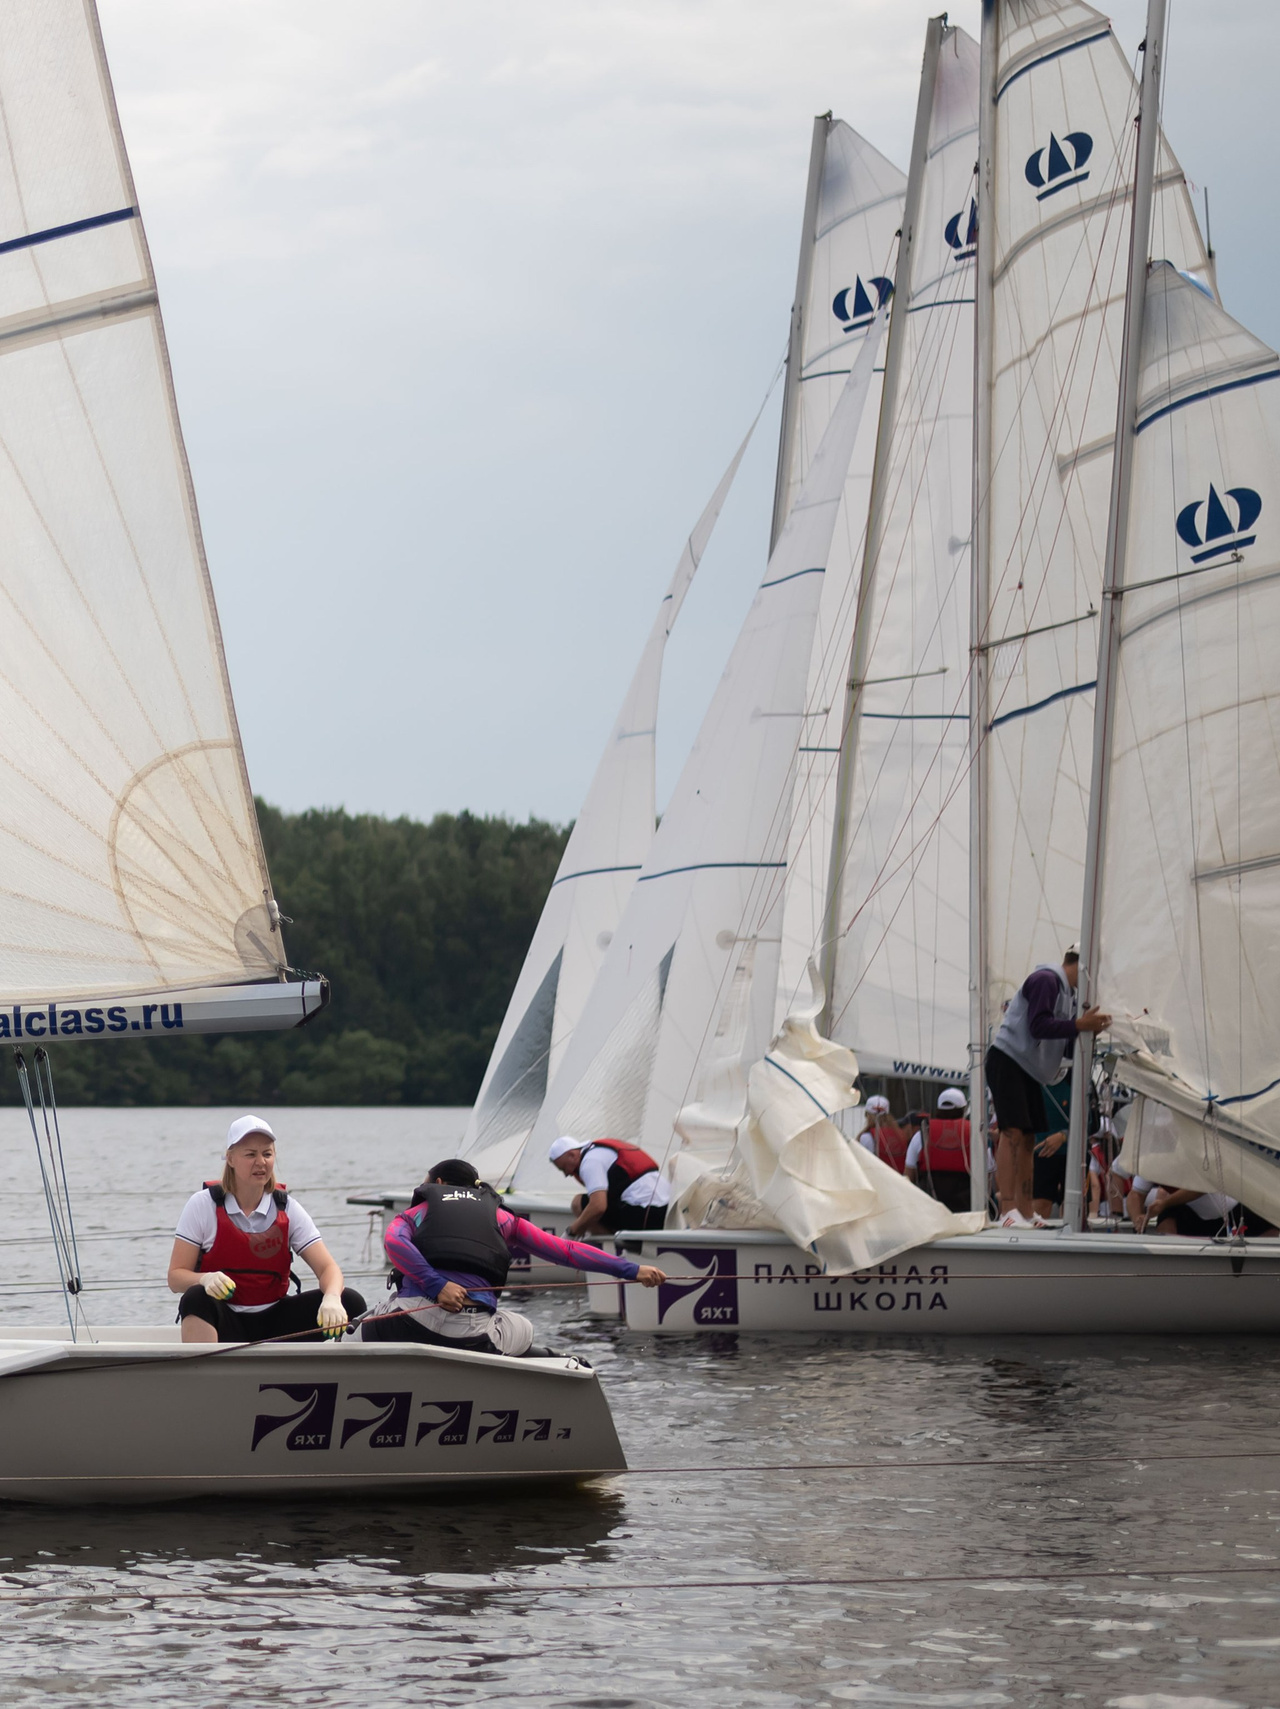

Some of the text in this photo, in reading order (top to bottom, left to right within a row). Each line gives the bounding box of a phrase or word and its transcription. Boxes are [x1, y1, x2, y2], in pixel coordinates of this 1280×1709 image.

[754, 1264, 948, 1285] ПАРСНАЯ
[814, 1292, 948, 1312] ШКОЛА
[700, 1307, 733, 1320] ЯХТ
[293, 1434, 326, 1445] ЯХТ
[375, 1434, 403, 1444] ЯХТ
[442, 1434, 465, 1442] ЯХТ
